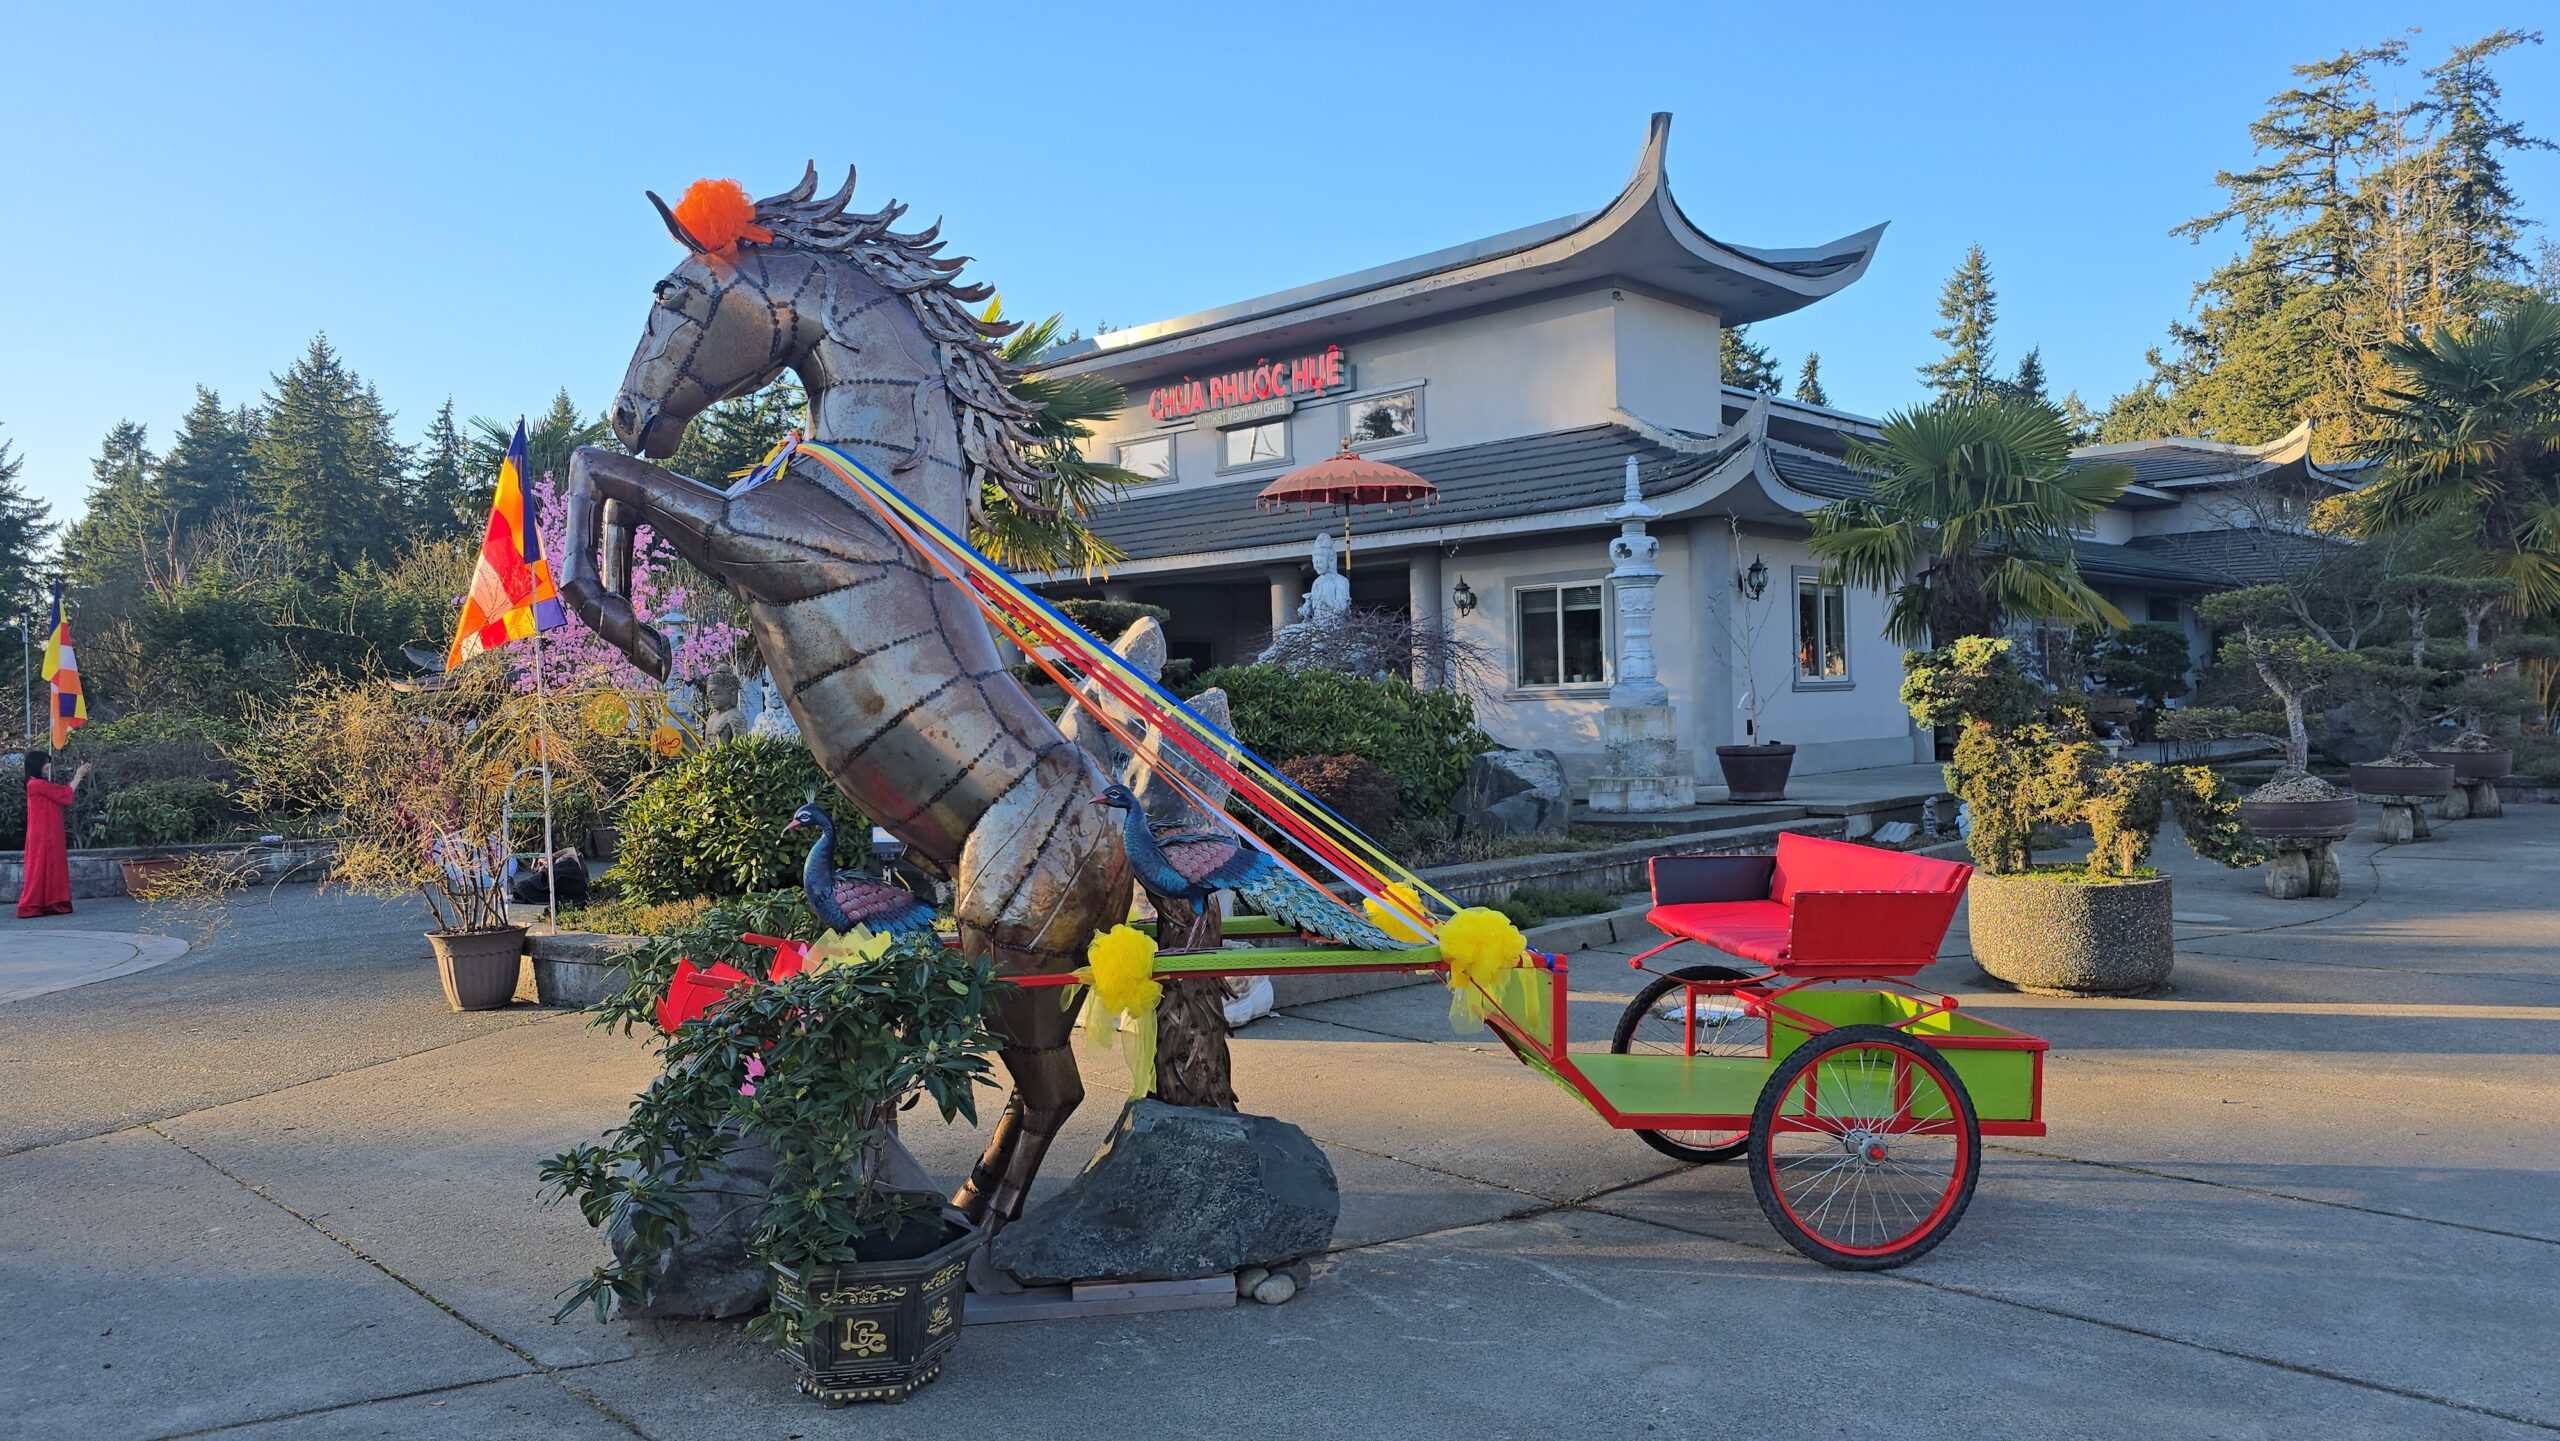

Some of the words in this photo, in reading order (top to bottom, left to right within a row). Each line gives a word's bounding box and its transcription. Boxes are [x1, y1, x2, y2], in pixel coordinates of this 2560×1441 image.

[1149, 375, 1205, 420] CHÙA
[1197, 411, 1226, 428] BUDDHIST
[1227, 404, 1263, 423] MEDITATION
[1263, 399, 1287, 416] CENTER
